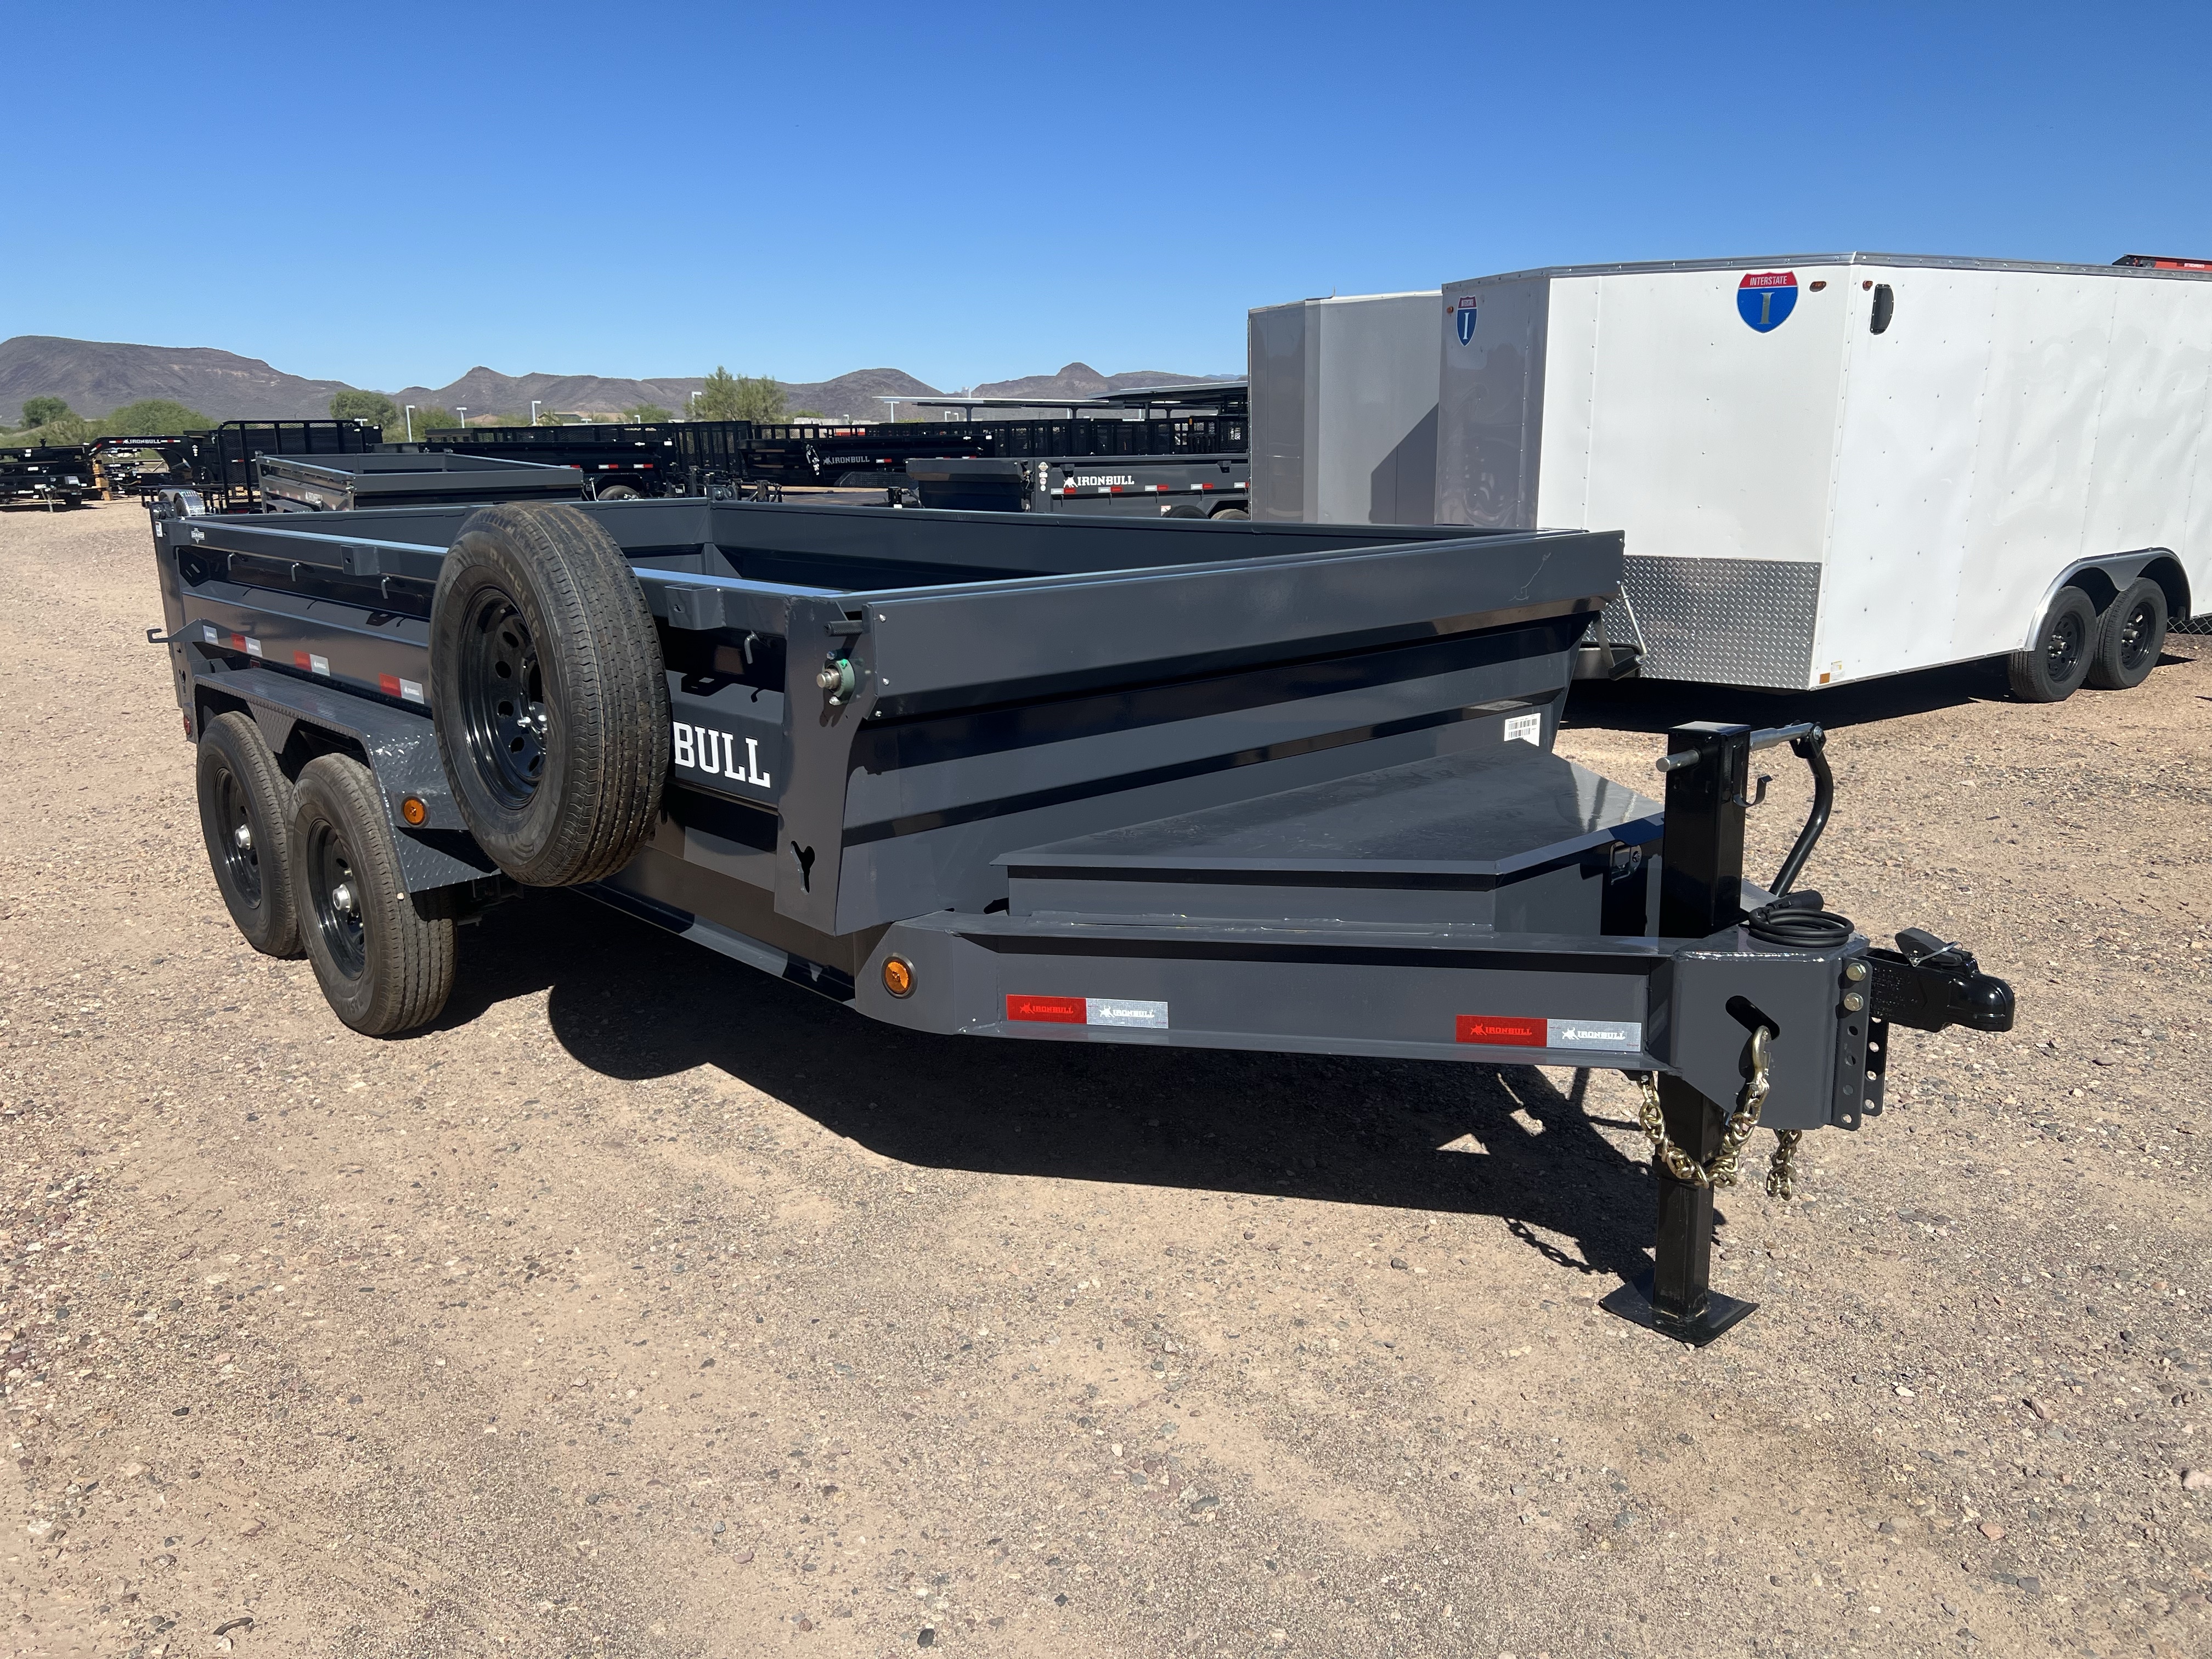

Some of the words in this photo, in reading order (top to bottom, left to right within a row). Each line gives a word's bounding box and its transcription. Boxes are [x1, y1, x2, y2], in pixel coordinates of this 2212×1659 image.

[1750, 275, 1787, 286] INTERSTATE
[1757, 292, 1775, 325] I
[1463, 312, 1470, 340] I
[832, 456, 870, 464] IRONBULL
[1077, 475, 1135, 487] IRONBULL
[673, 721, 771, 788] BULL
[1032, 1006, 1074, 1014] IRONBULL
[1113, 1009, 1155, 1018] IRONBULL
[1486, 1026, 1532, 1035] IRONBULL
[1577, 1031, 1626, 1040] IRONBULL
